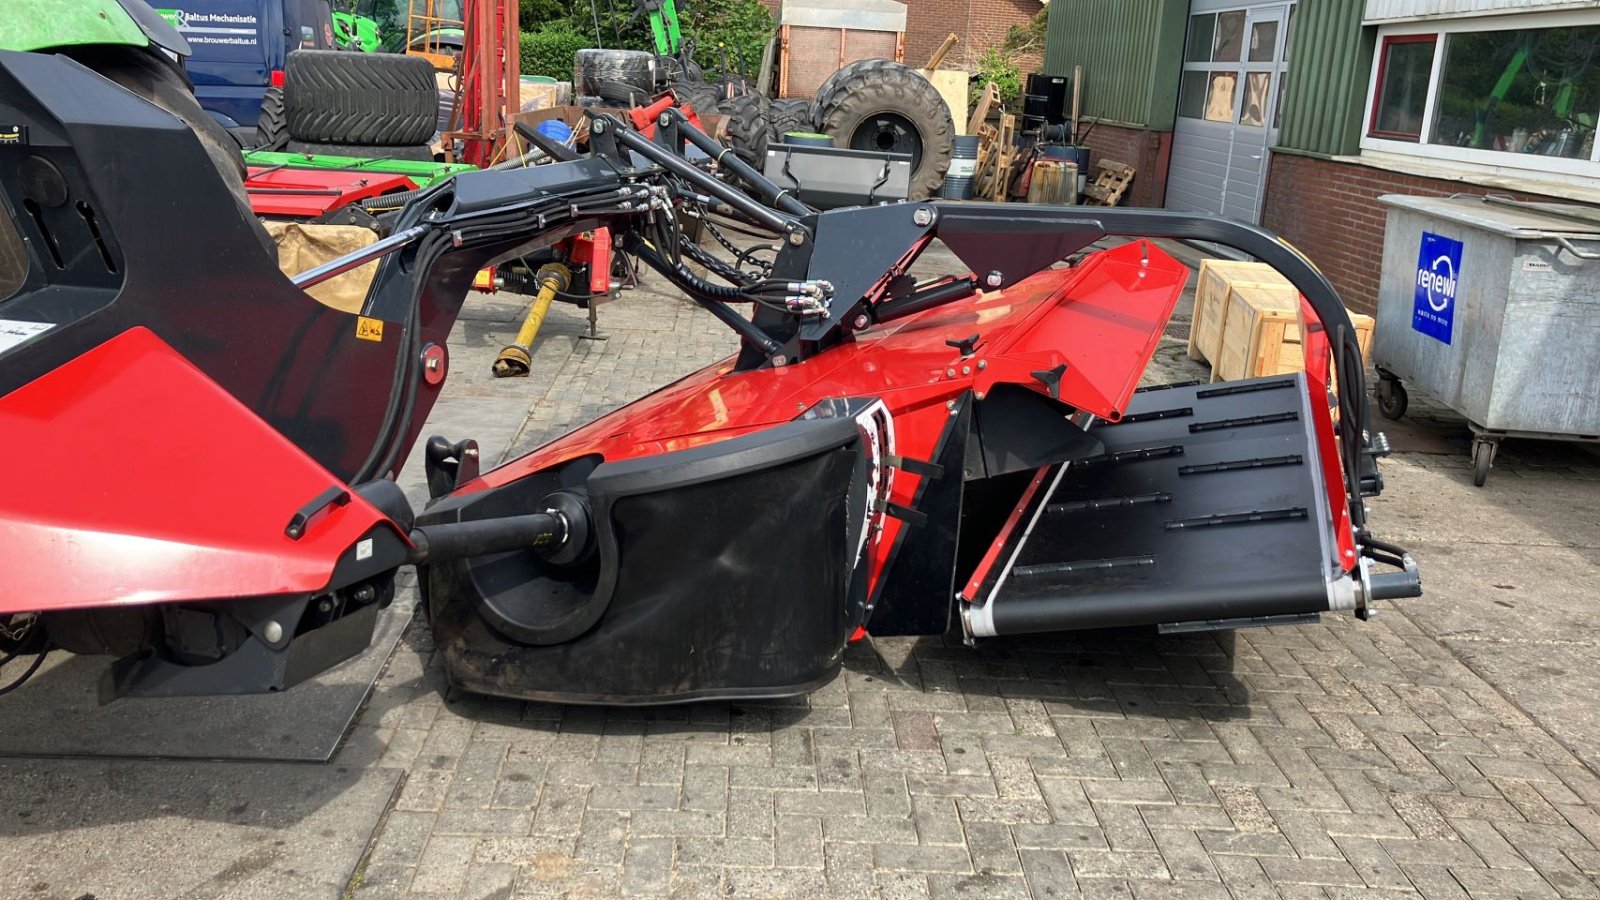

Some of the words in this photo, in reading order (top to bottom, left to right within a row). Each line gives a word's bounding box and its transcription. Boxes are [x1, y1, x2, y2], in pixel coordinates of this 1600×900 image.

[185, 12, 208, 22] Baltus
[209, 13, 257, 23] Mechanisatie
[187, 36, 257, 45] www.brouwerbaltus.nl
[1417, 268, 1456, 298] renewi
